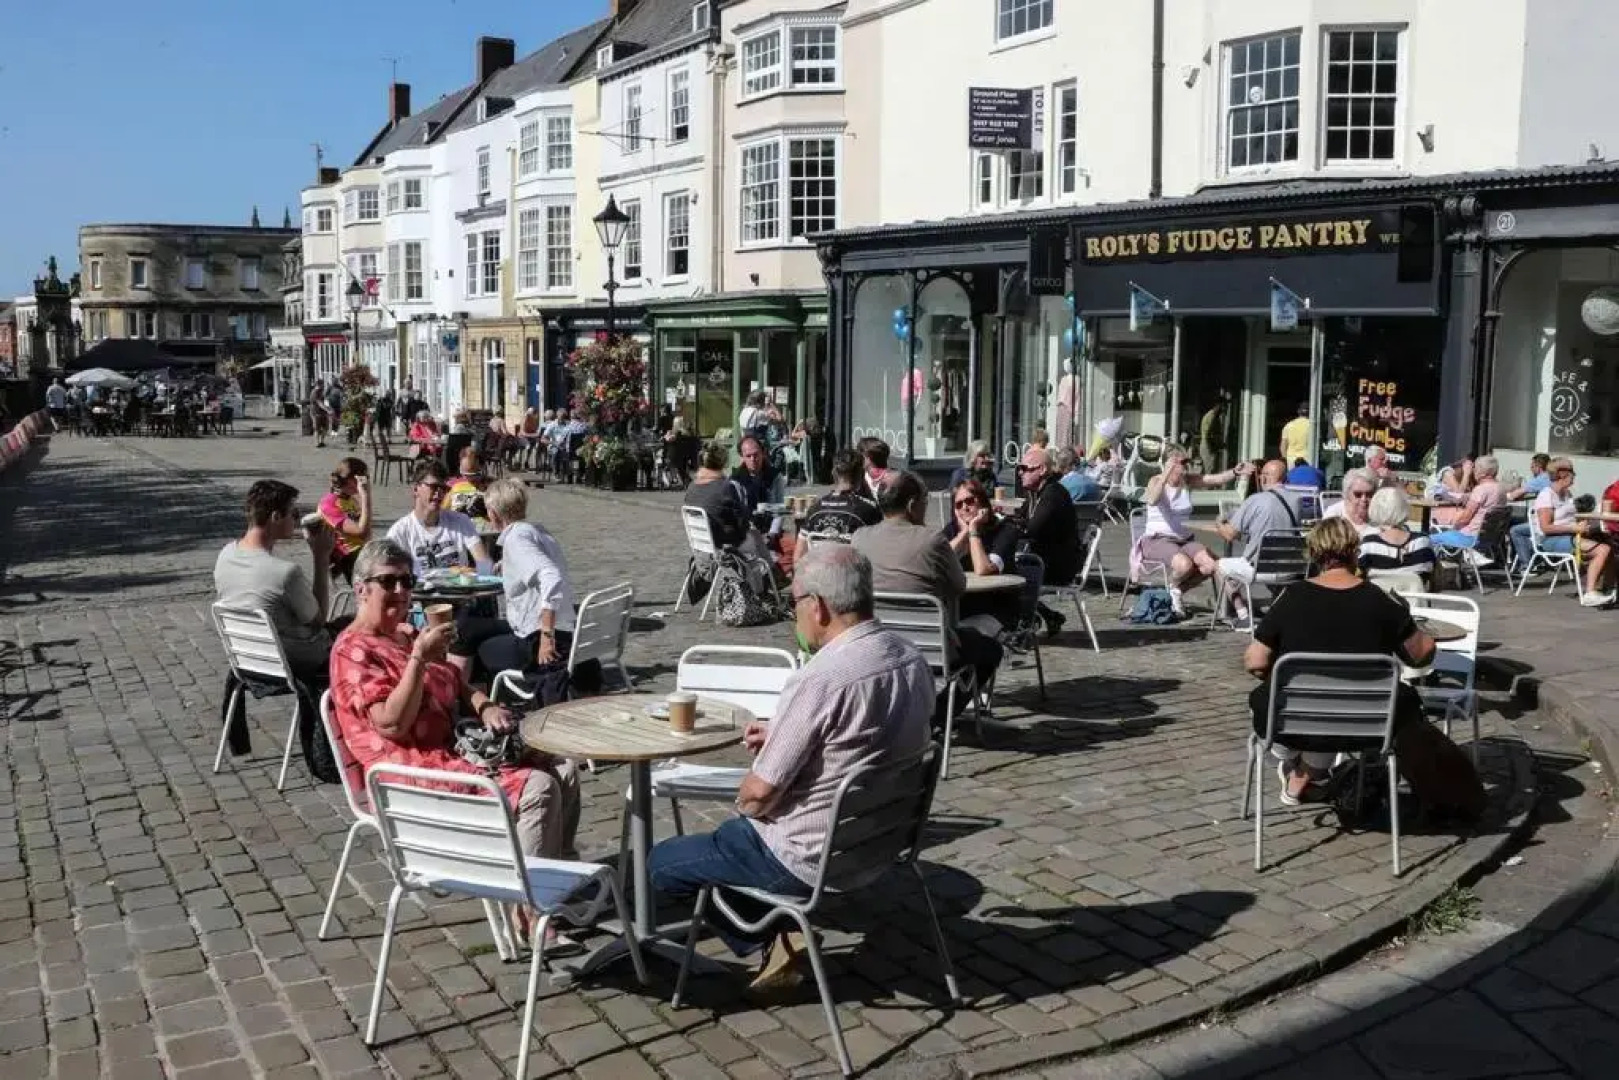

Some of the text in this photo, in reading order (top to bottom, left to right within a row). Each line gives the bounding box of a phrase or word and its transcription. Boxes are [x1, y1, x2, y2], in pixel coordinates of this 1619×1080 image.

[1086, 219, 1372, 258] ROLY'S FUDGE PANTRY
[1358, 379, 1397, 395] Free
[1553, 371, 1577, 384] AFE
[1358, 396, 1417, 430] Fudge
[1555, 395, 1573, 411] 21
[1349, 421, 1405, 451] Crumbs
